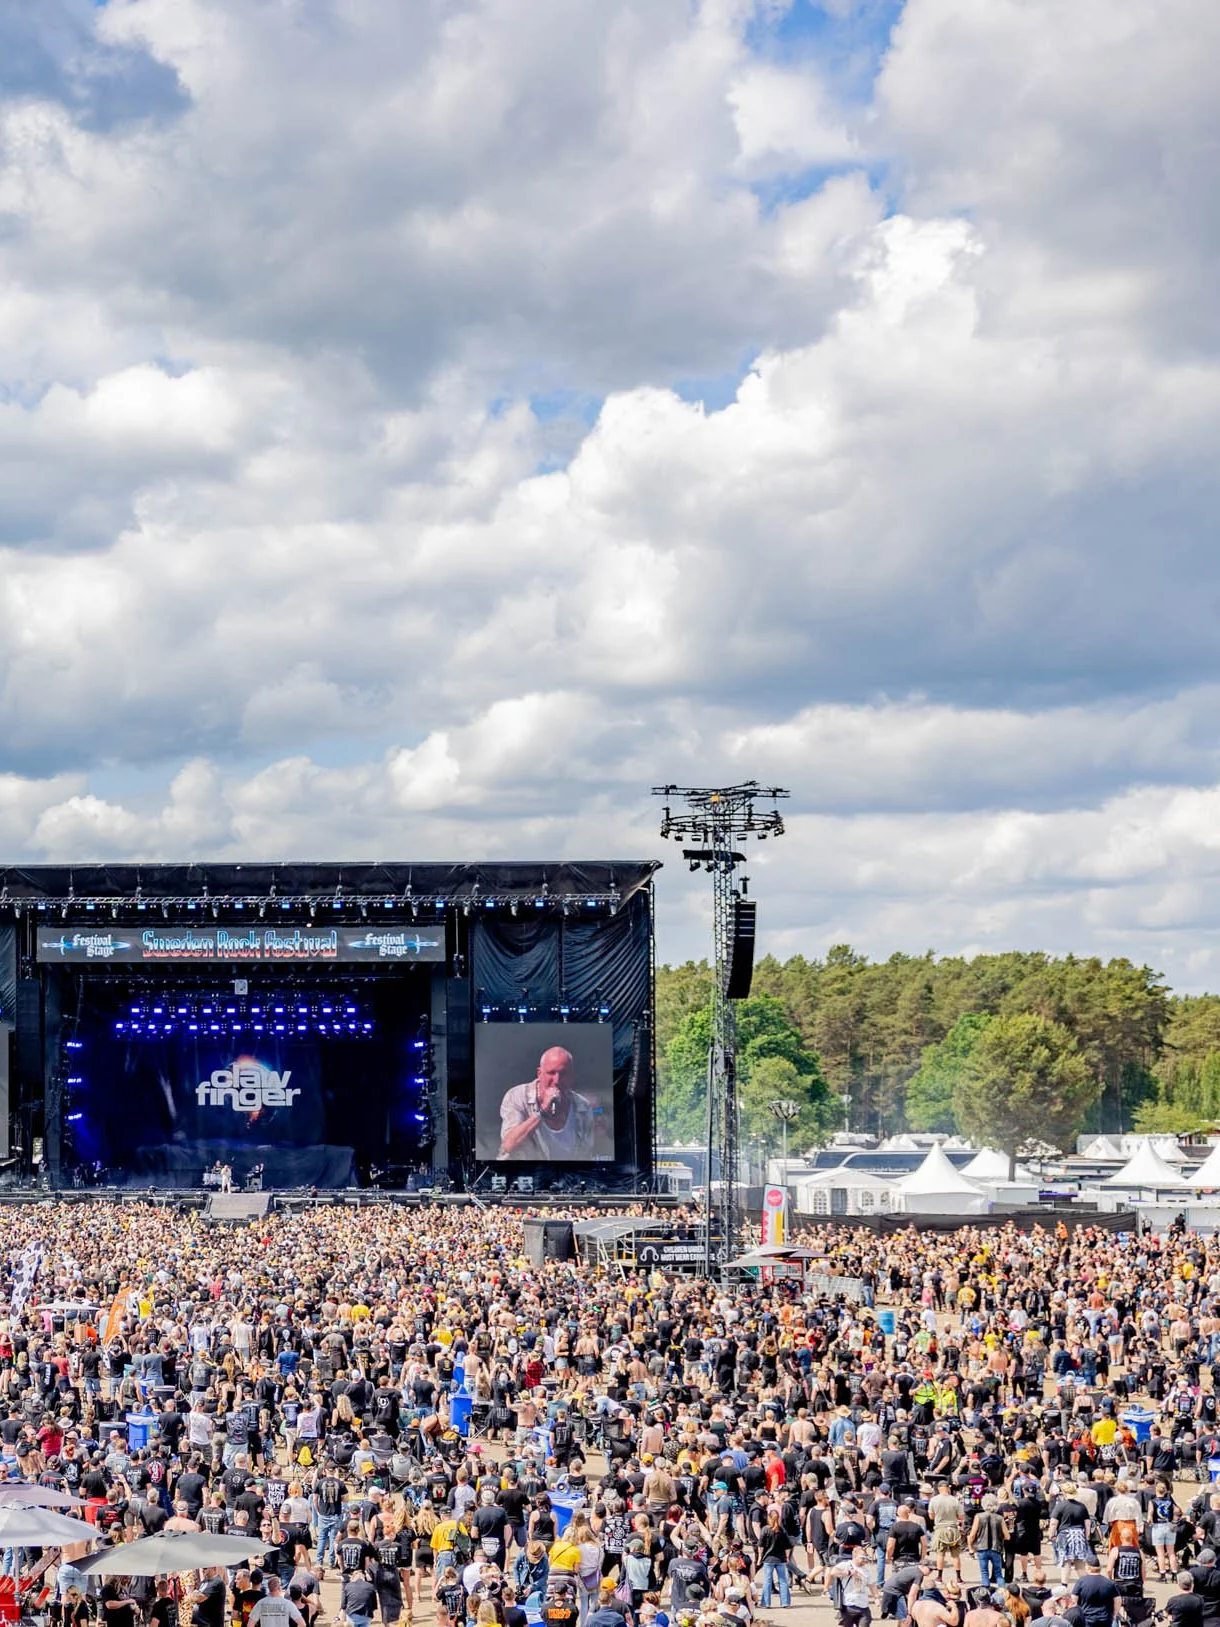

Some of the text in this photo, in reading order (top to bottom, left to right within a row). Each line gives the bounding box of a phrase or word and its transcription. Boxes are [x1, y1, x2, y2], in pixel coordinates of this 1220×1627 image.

[73, 934, 112, 948] Festival
[142, 930, 337, 958] Sweden Rock Festival
[365, 933, 404, 946] Festival
[87, 944, 114, 957] Stage
[379, 943, 407, 957] Stage
[210, 1064, 292, 1088] claw
[195, 1081, 301, 1111] finger
